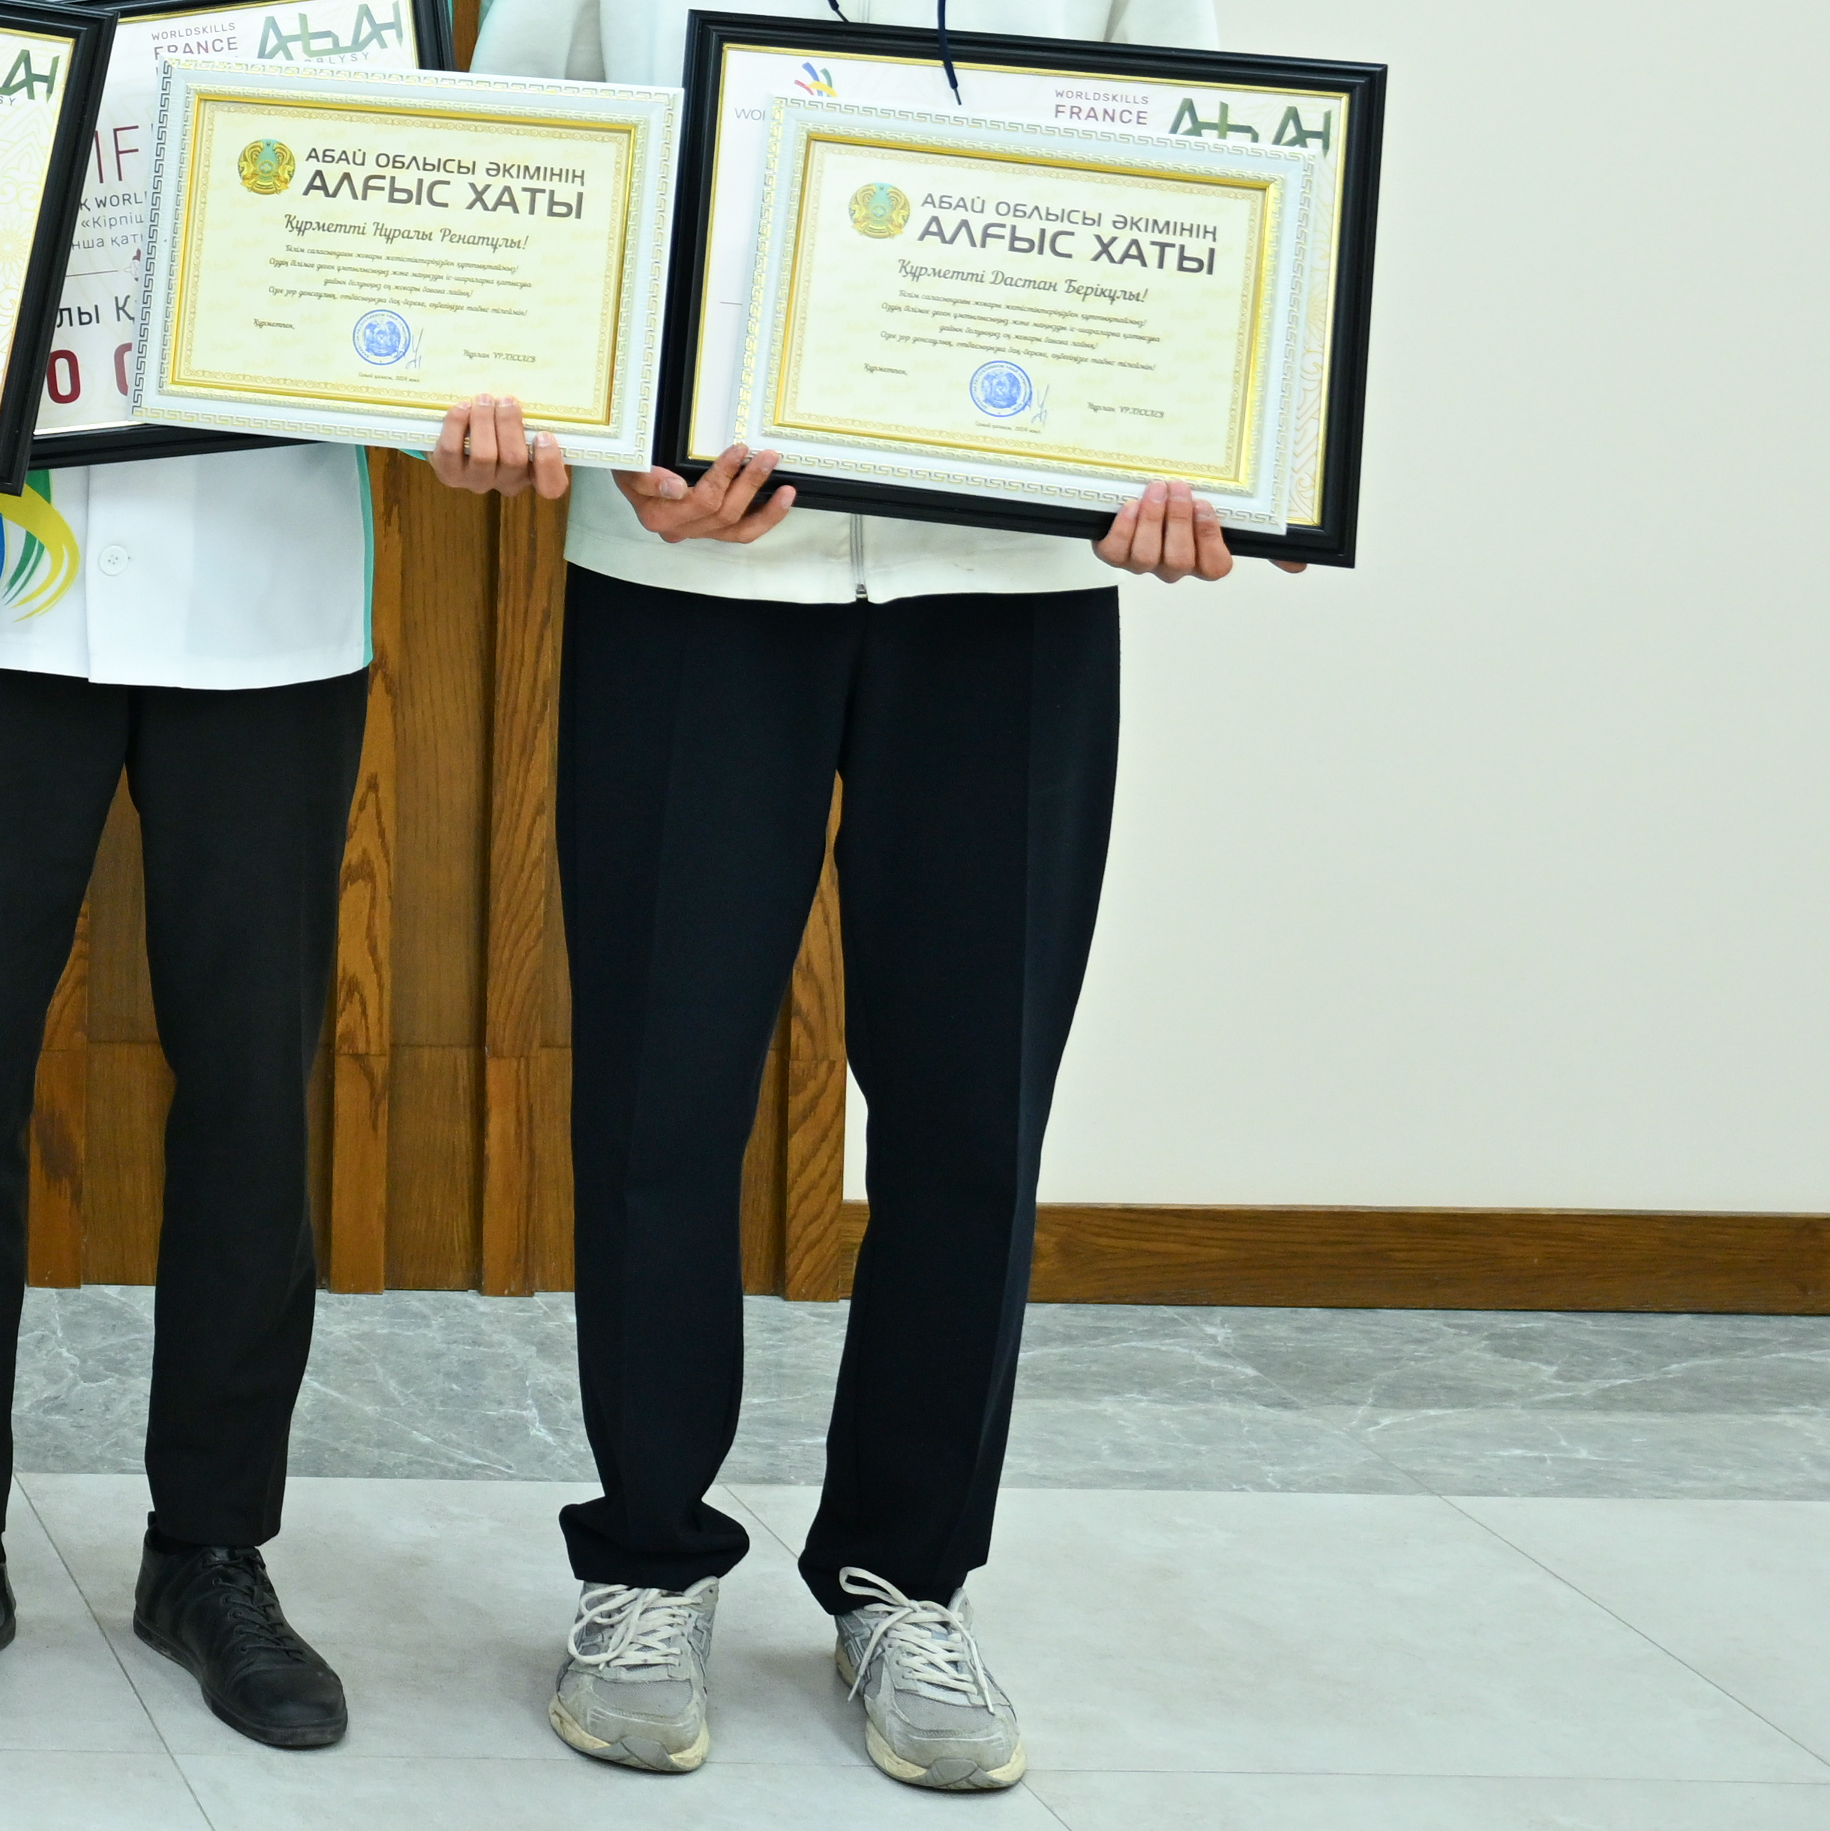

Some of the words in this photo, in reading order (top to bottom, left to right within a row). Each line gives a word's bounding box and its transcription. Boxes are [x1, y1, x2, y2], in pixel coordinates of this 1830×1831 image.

[151, 22, 237, 41] WORLDSKILLS
[1054, 88, 1150, 106] WORLDSKILLS
[1054, 103, 1149, 126] FRANCE
[304, 146, 367, 167] АБАЙ
[374, 151, 477, 176] ОБЛЫСЫ
[484, 160, 585, 187] ӘКІМІНІҢ
[301, 168, 451, 209] АЛҒЫС
[464, 181, 584, 220] ХАТЫ
[283, 212, 367, 237] Құрметті
[371, 220, 433, 245] Нұралы
[438, 226, 530, 254] Ренатұлы!
[919, 191, 986, 214] АБАЙ
[994, 200, 1102, 228] ОБЛЫСЫ
[1110, 213, 1217, 243] ӘКІМІНІҢ
[916, 214, 1076, 259] АЛҒЫС
[1089, 232, 1216, 276] ХАТЫ
[897, 257, 986, 284] Құрметті
[988, 269, 1058, 292] Дастан
[1063, 277, 1149, 306] Берікұлы!
